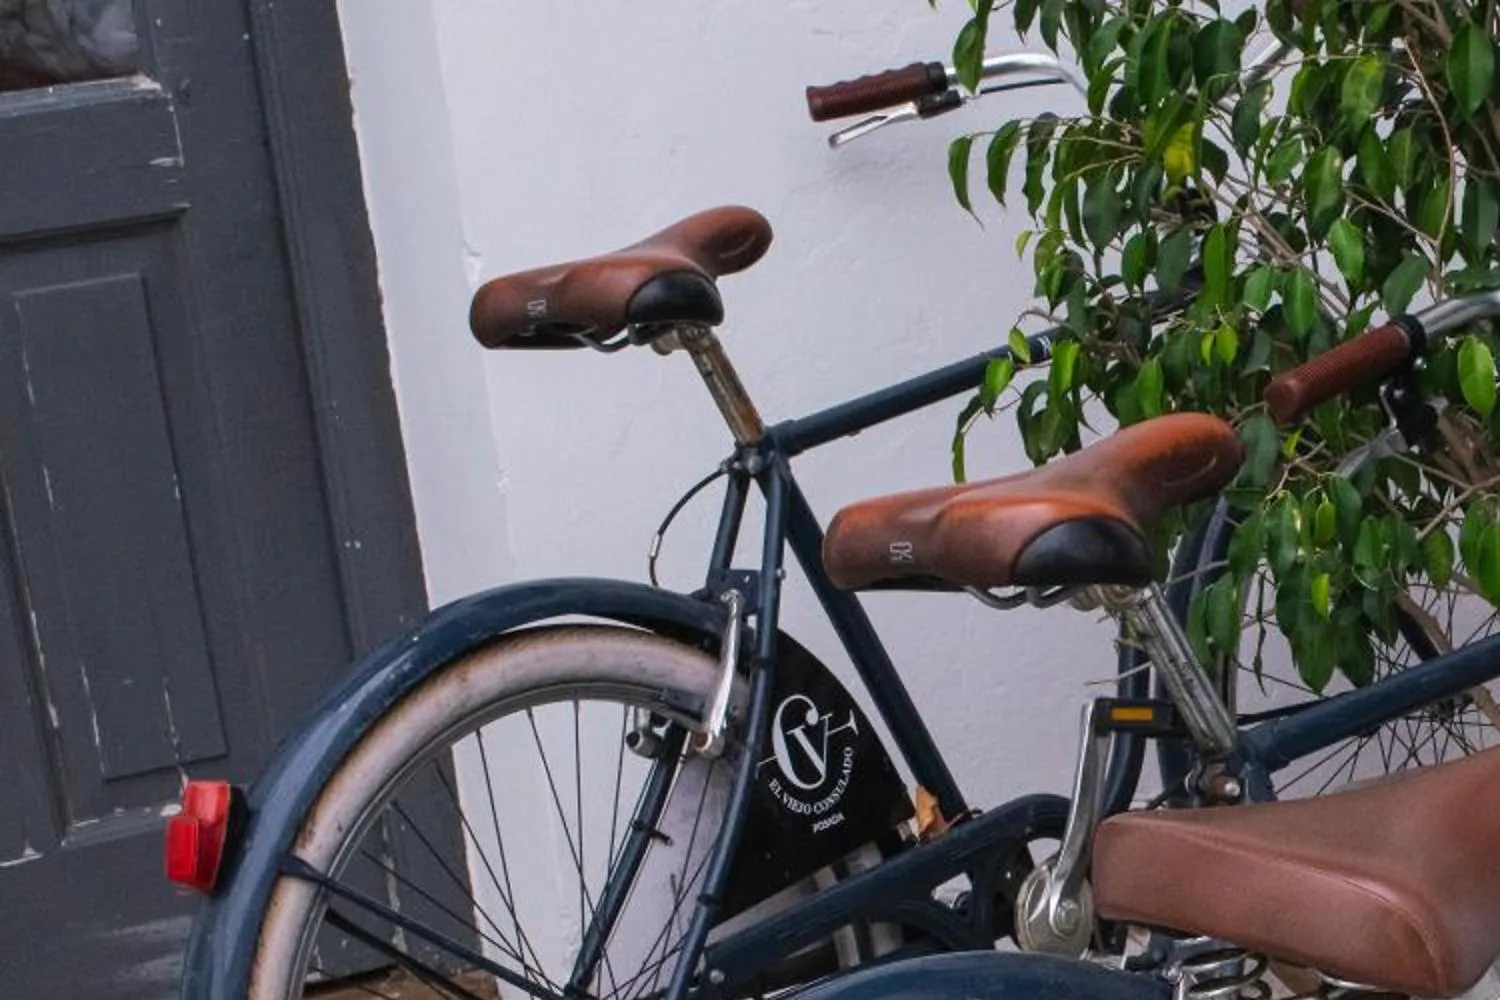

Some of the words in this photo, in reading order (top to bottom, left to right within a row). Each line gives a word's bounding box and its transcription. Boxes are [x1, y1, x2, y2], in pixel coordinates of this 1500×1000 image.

[767, 778, 781, 799] EL
[782, 793, 813, 815] VIEJO
[813, 746, 854, 815] CONSULADO
[812, 812, 845, 834] POSADA
